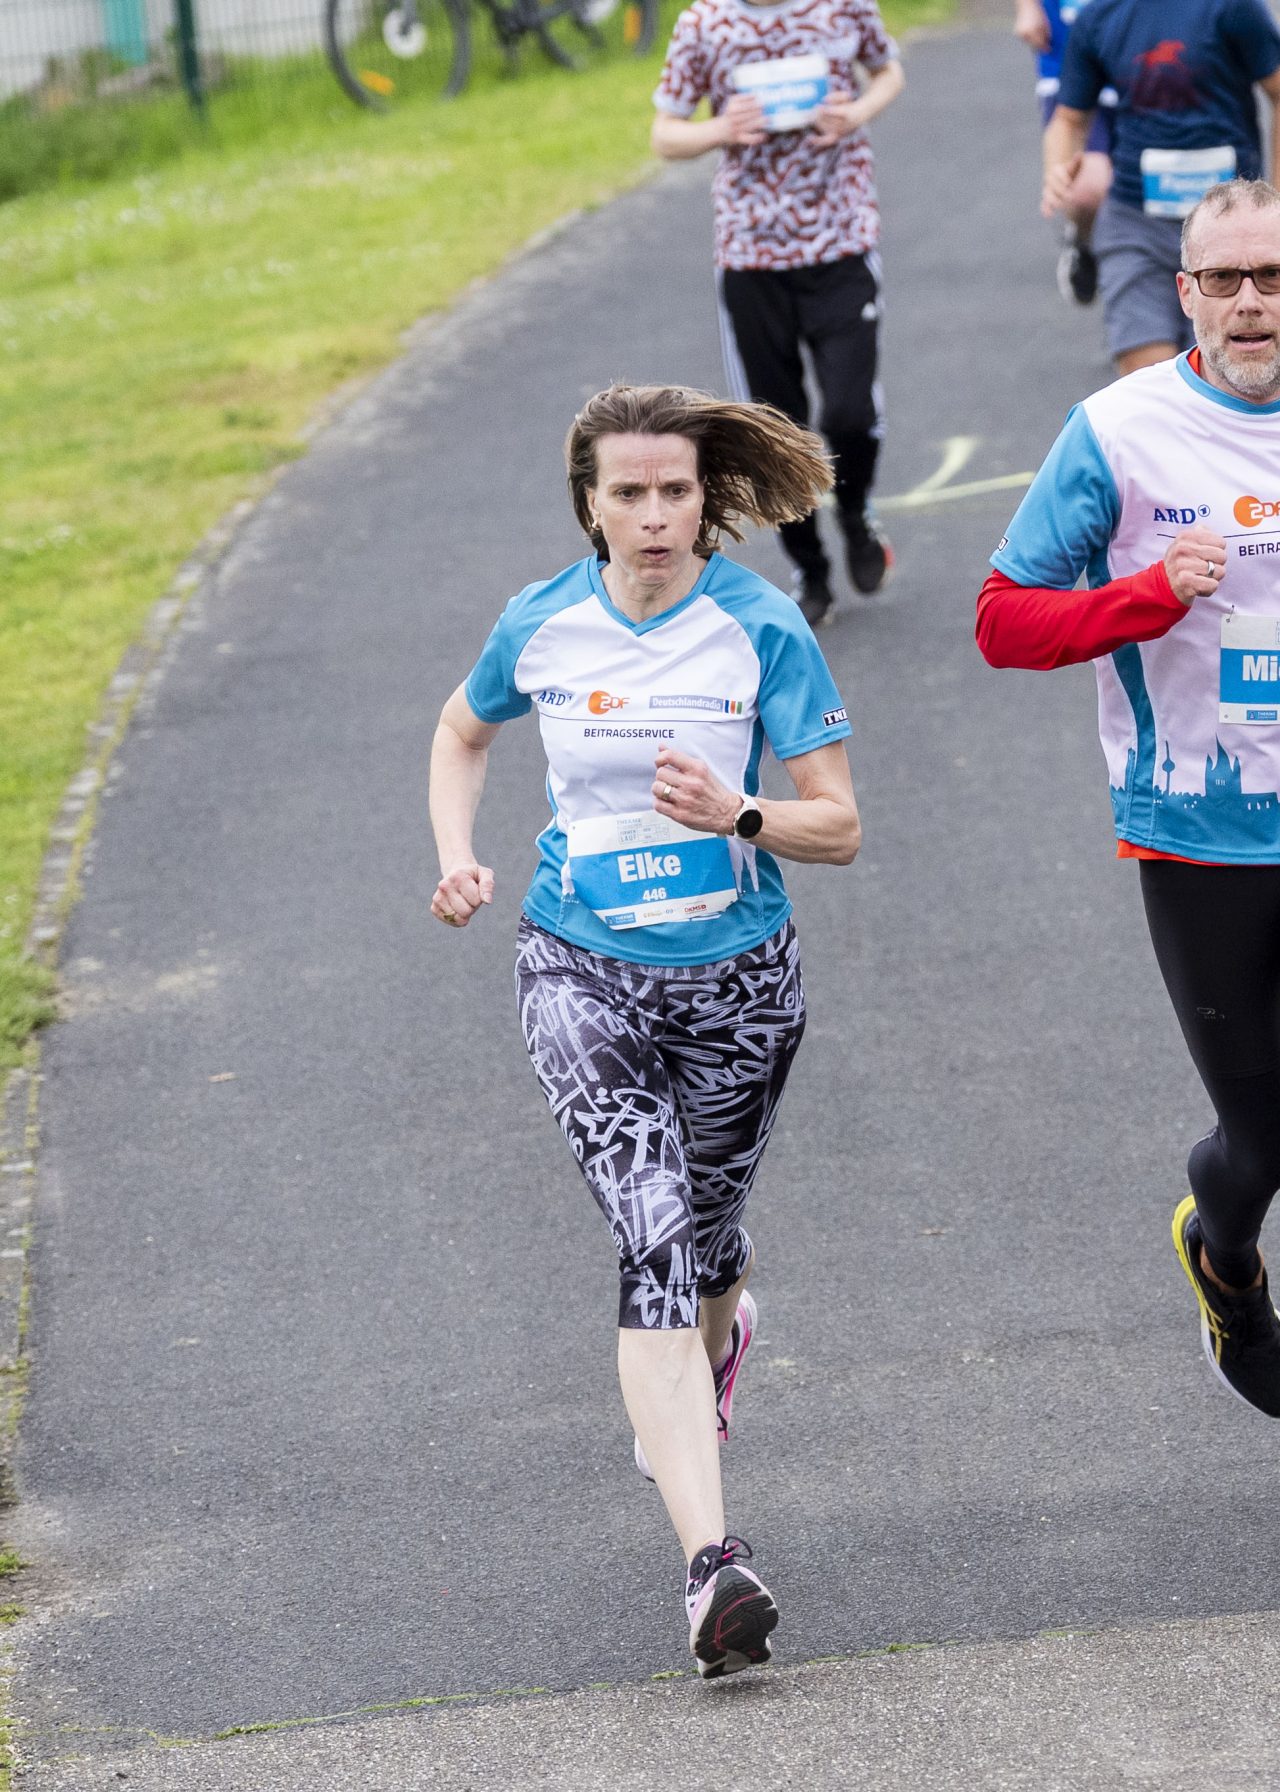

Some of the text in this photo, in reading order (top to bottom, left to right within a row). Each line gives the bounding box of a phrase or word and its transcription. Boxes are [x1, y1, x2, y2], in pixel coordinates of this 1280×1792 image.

[1153, 508, 1196, 524] ARD
[537, 690, 566, 706] ARD
[652, 696, 721, 710] Deutschlandradio
[583, 728, 676, 738] BEITRAGSSERVICE
[617, 851, 681, 883] Elke
[642, 887, 667, 901] 446
